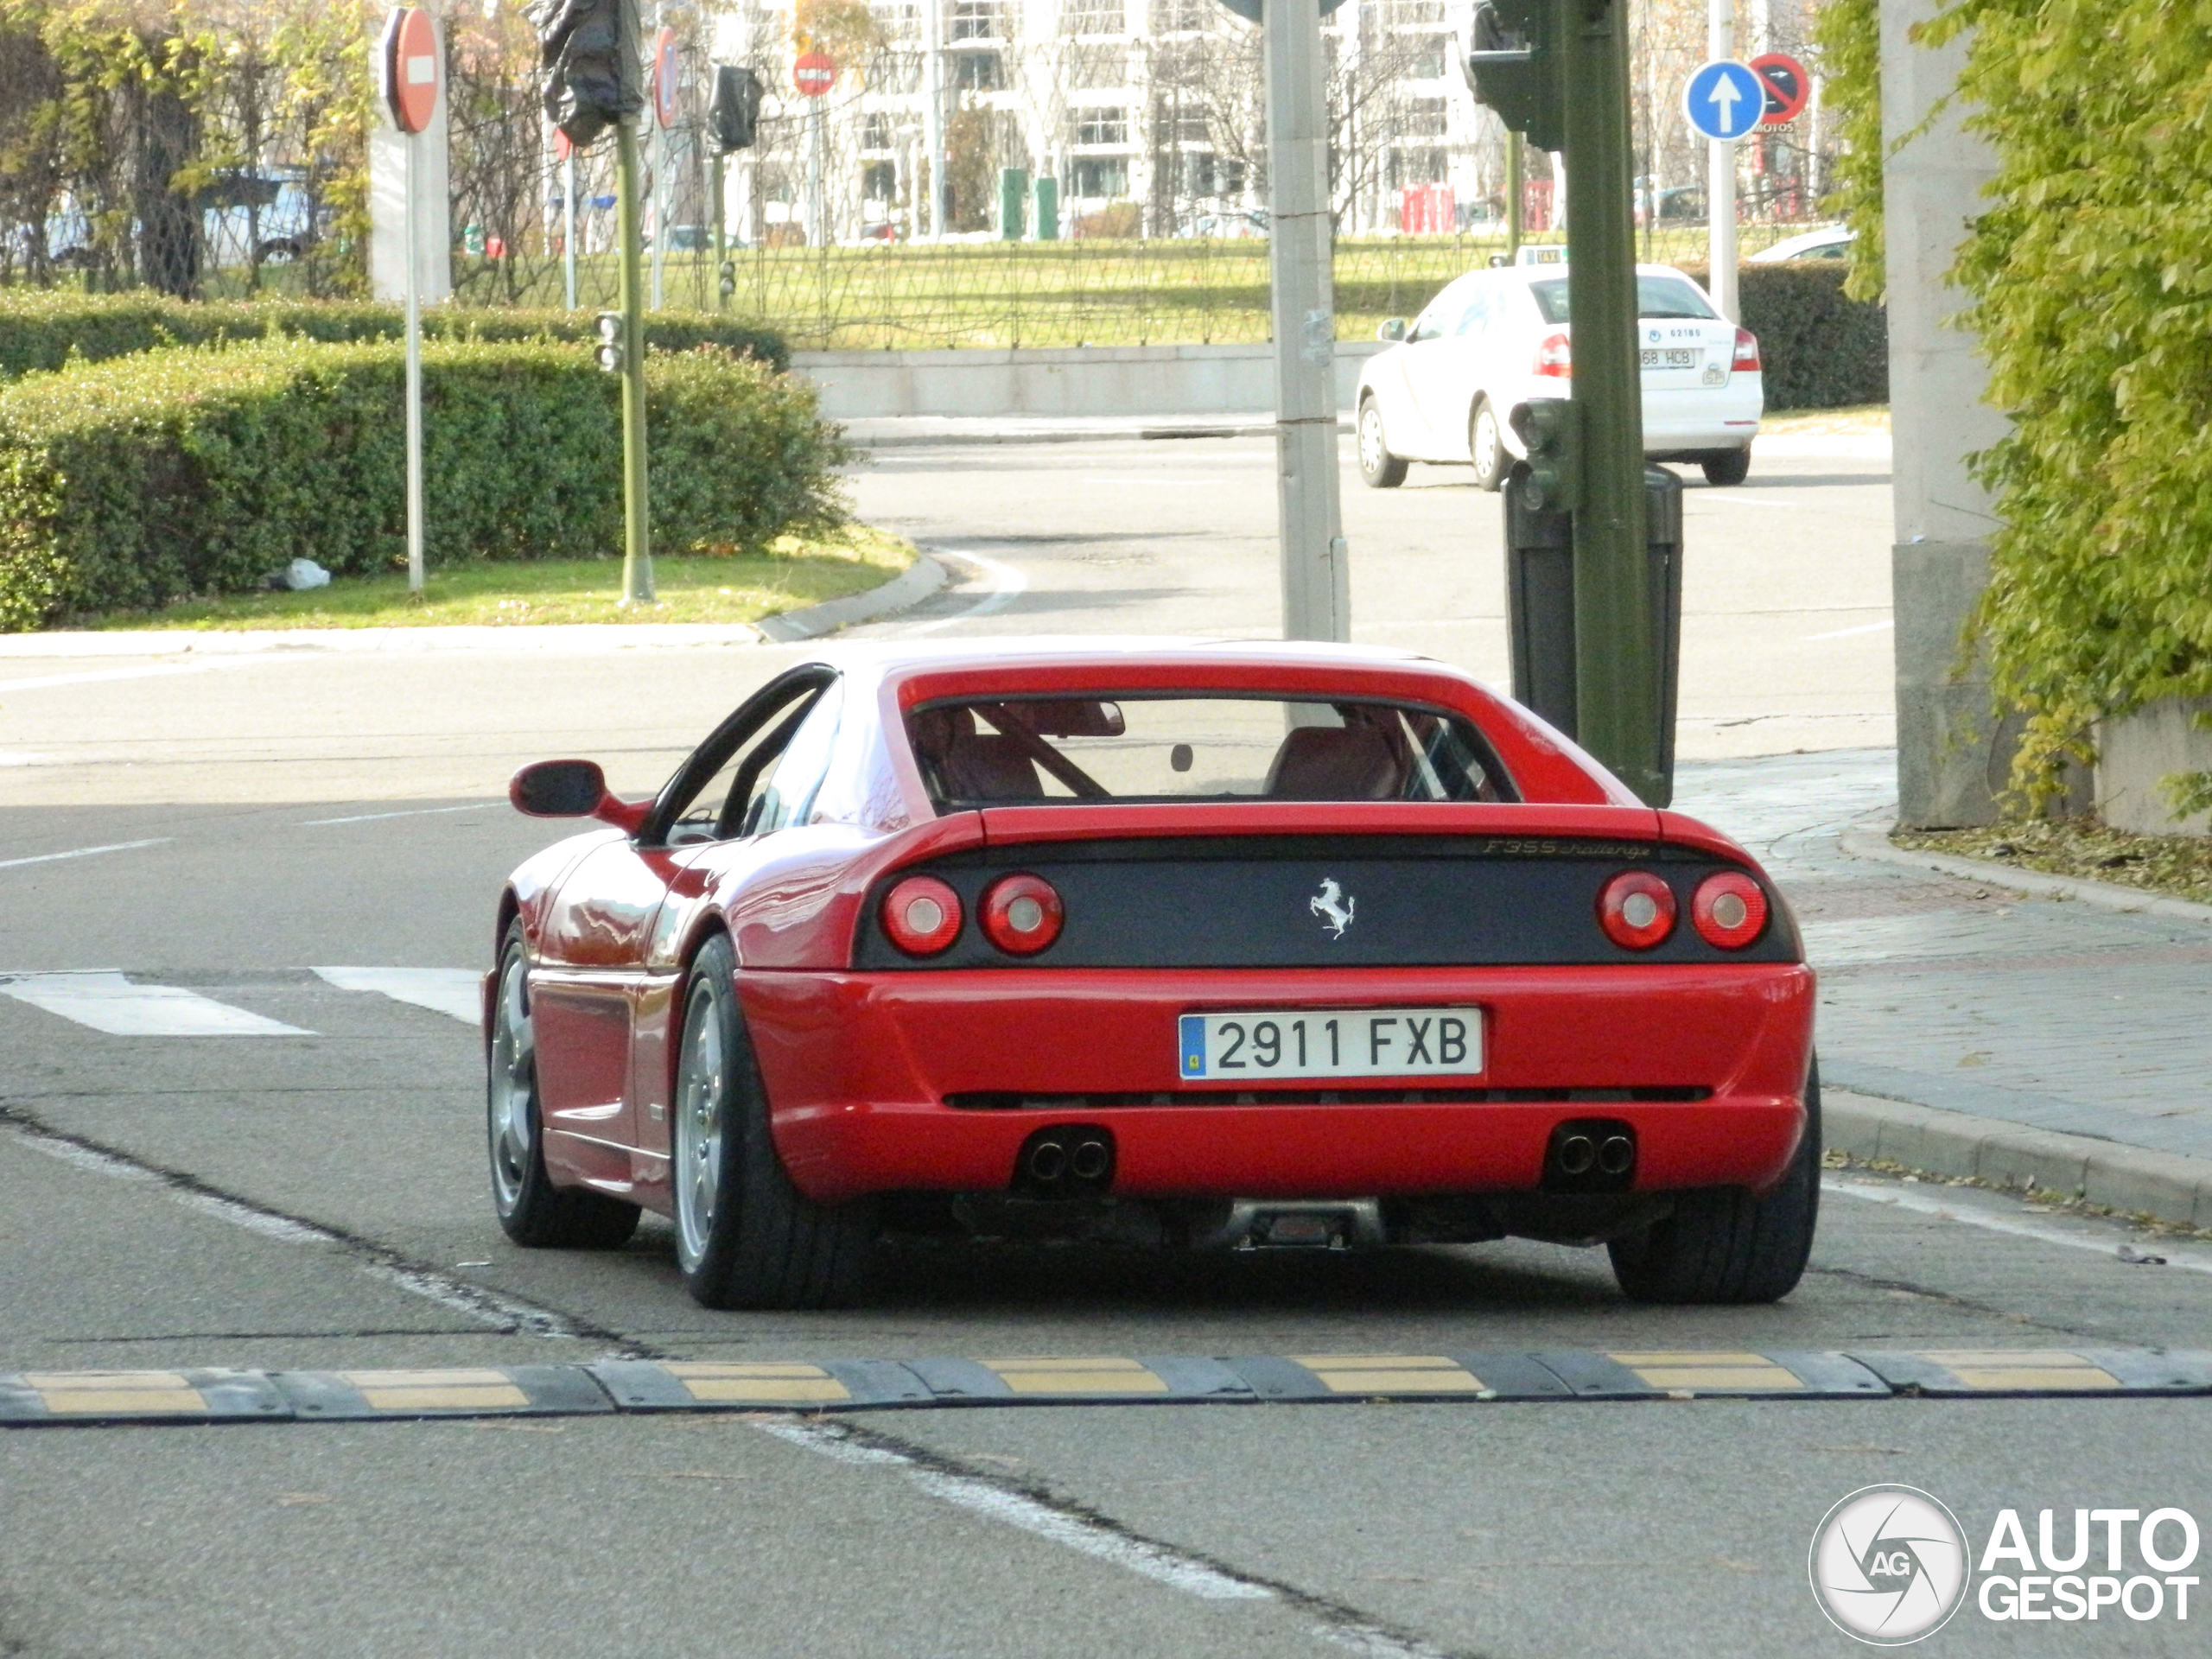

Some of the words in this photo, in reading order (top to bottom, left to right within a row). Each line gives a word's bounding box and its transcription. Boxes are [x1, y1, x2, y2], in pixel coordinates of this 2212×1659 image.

[1642, 352, 1658, 365] 68
[1665, 351, 1690, 364] HCB
[1217, 1019, 1339, 1069] 2911
[1370, 1017, 1467, 1066] FXB
